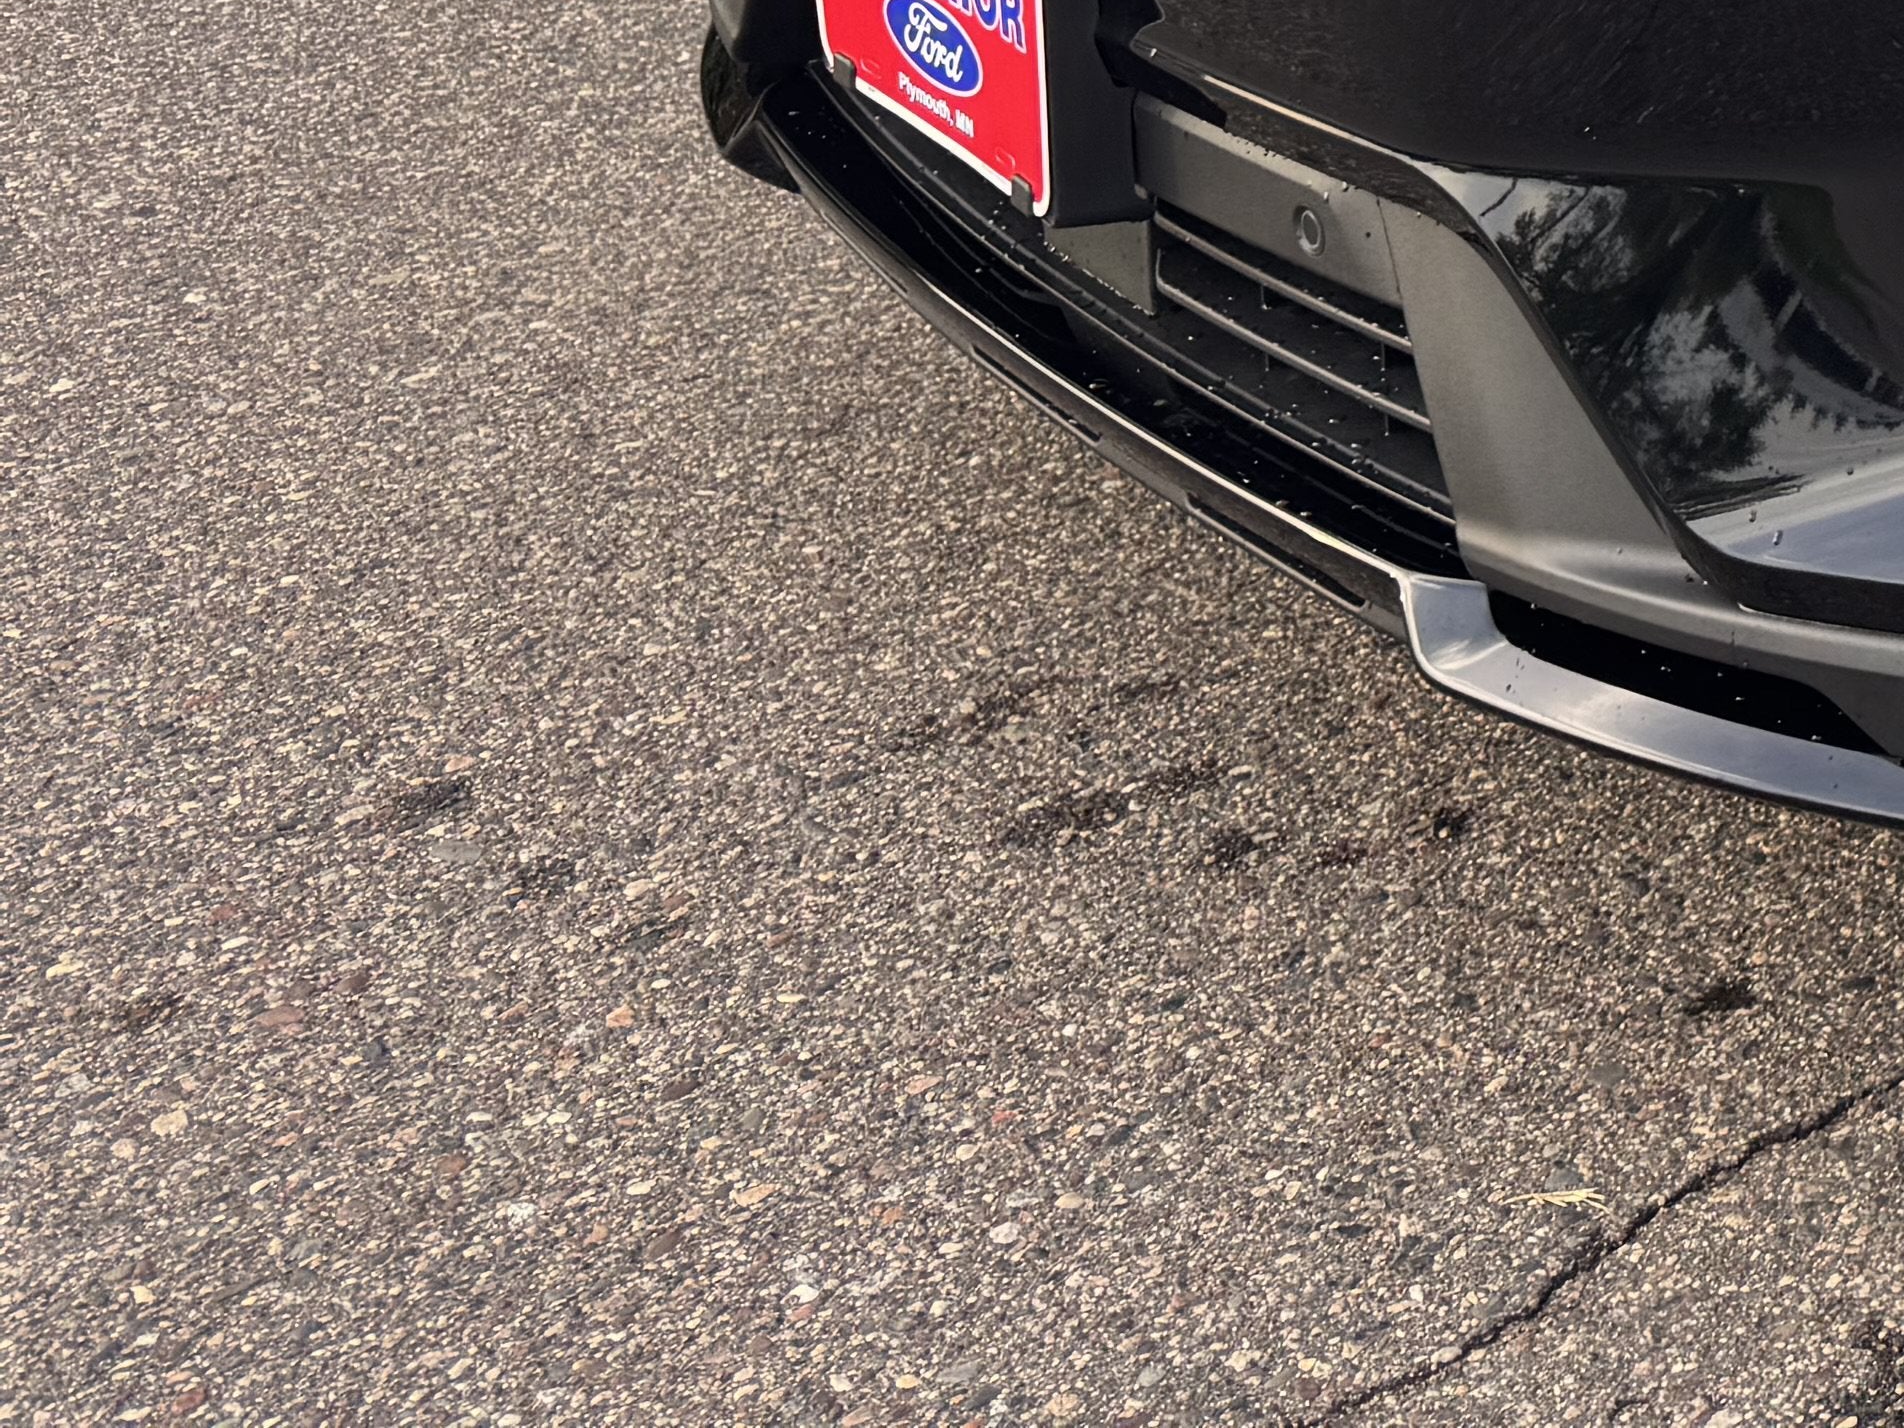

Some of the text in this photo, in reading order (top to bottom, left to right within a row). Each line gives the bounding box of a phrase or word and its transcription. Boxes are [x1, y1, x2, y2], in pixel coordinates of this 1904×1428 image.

[903, 1, 964, 83] Ford
[898, 70, 975, 139] Plymouth, MN
